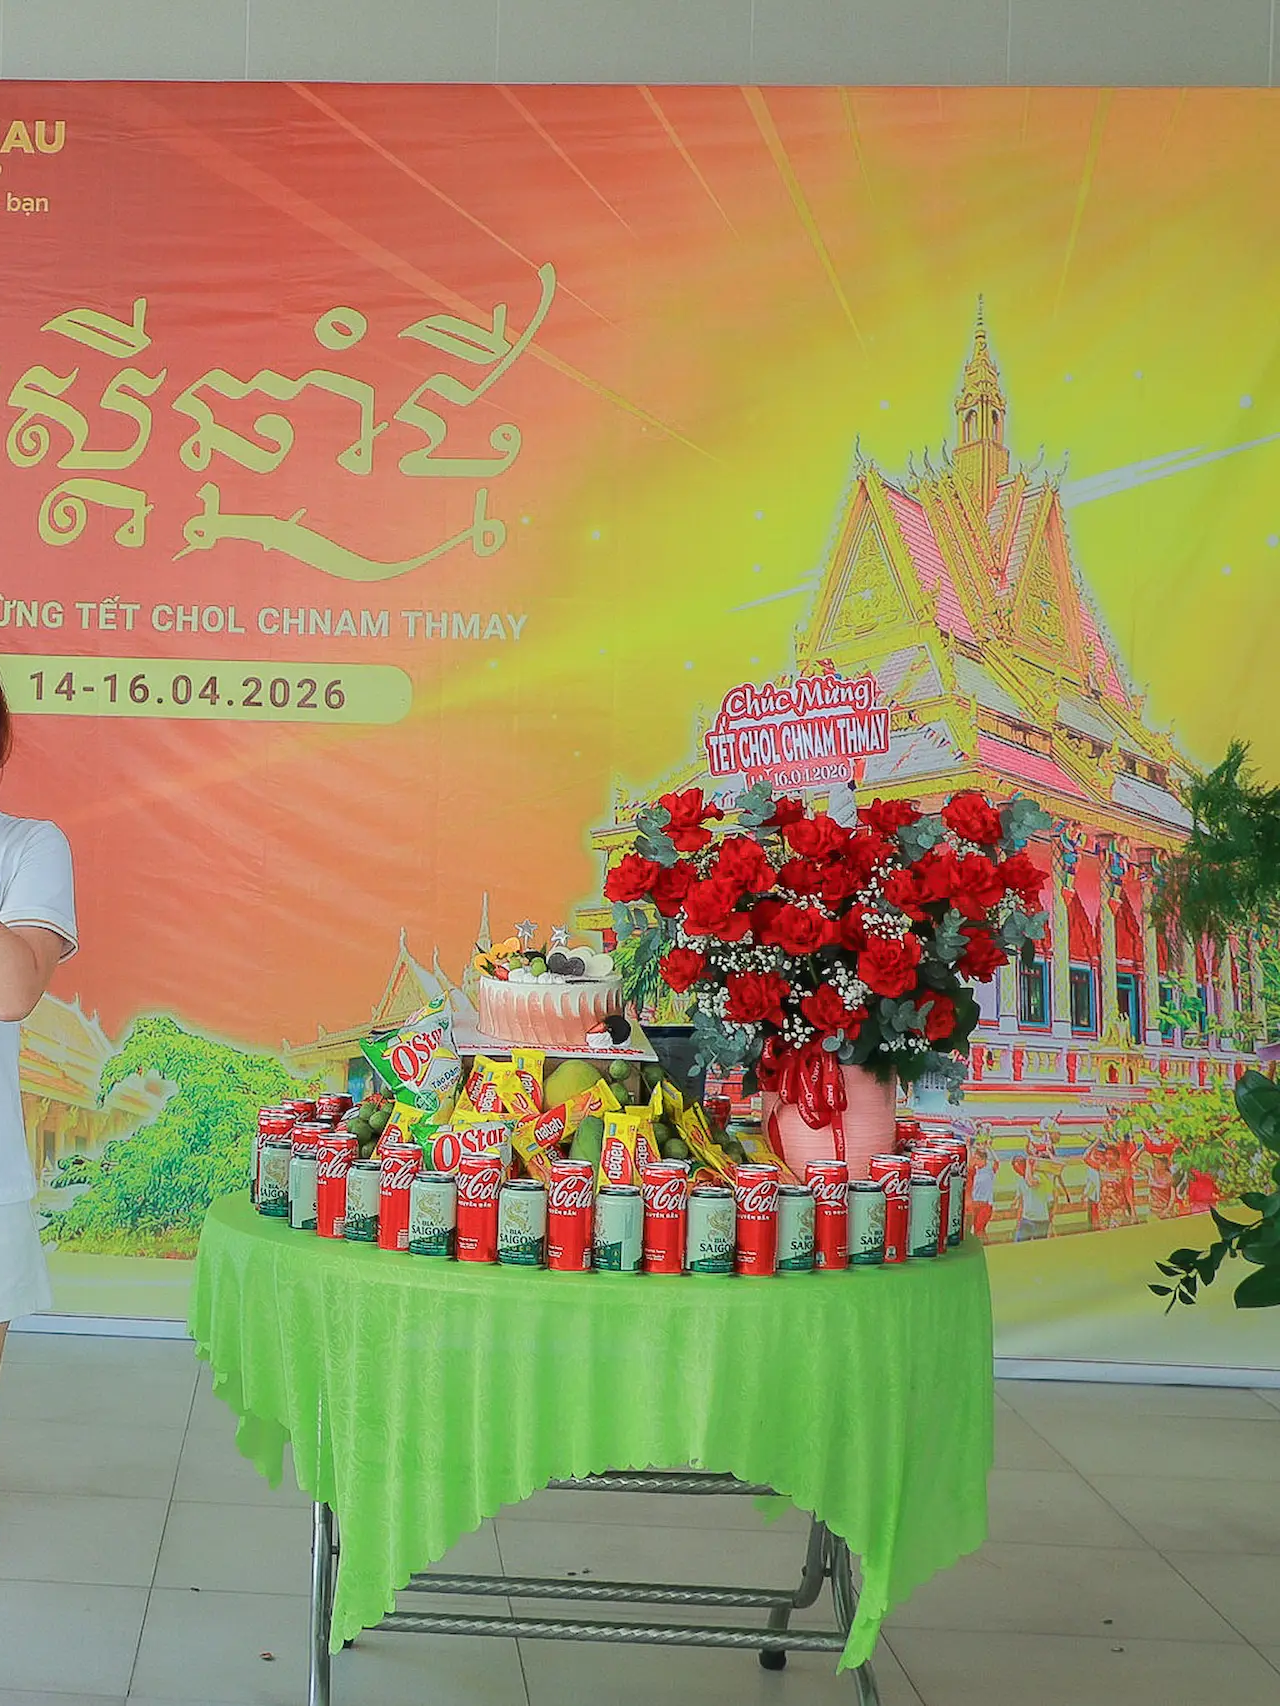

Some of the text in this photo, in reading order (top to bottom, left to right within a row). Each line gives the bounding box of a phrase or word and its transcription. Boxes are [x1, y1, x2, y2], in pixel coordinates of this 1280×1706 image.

[6, 192, 49, 216] bạn
[75, 595, 141, 632] TẾT
[151, 604, 245, 634] CHOL
[257, 607, 390, 638] CHNAM
[400, 609, 529, 641] THMAY
[29, 670, 346, 710] 14-16.04.2026
[726, 680, 869, 717] Chúc Mừng
[709, 713, 886, 773] TẾT CHOL CHNAM THMAY
[433, 1126, 506, 1172] O'Star
[411, 1224, 449, 1237] SAIGON
[499, 1233, 537, 1246] SAIGON
